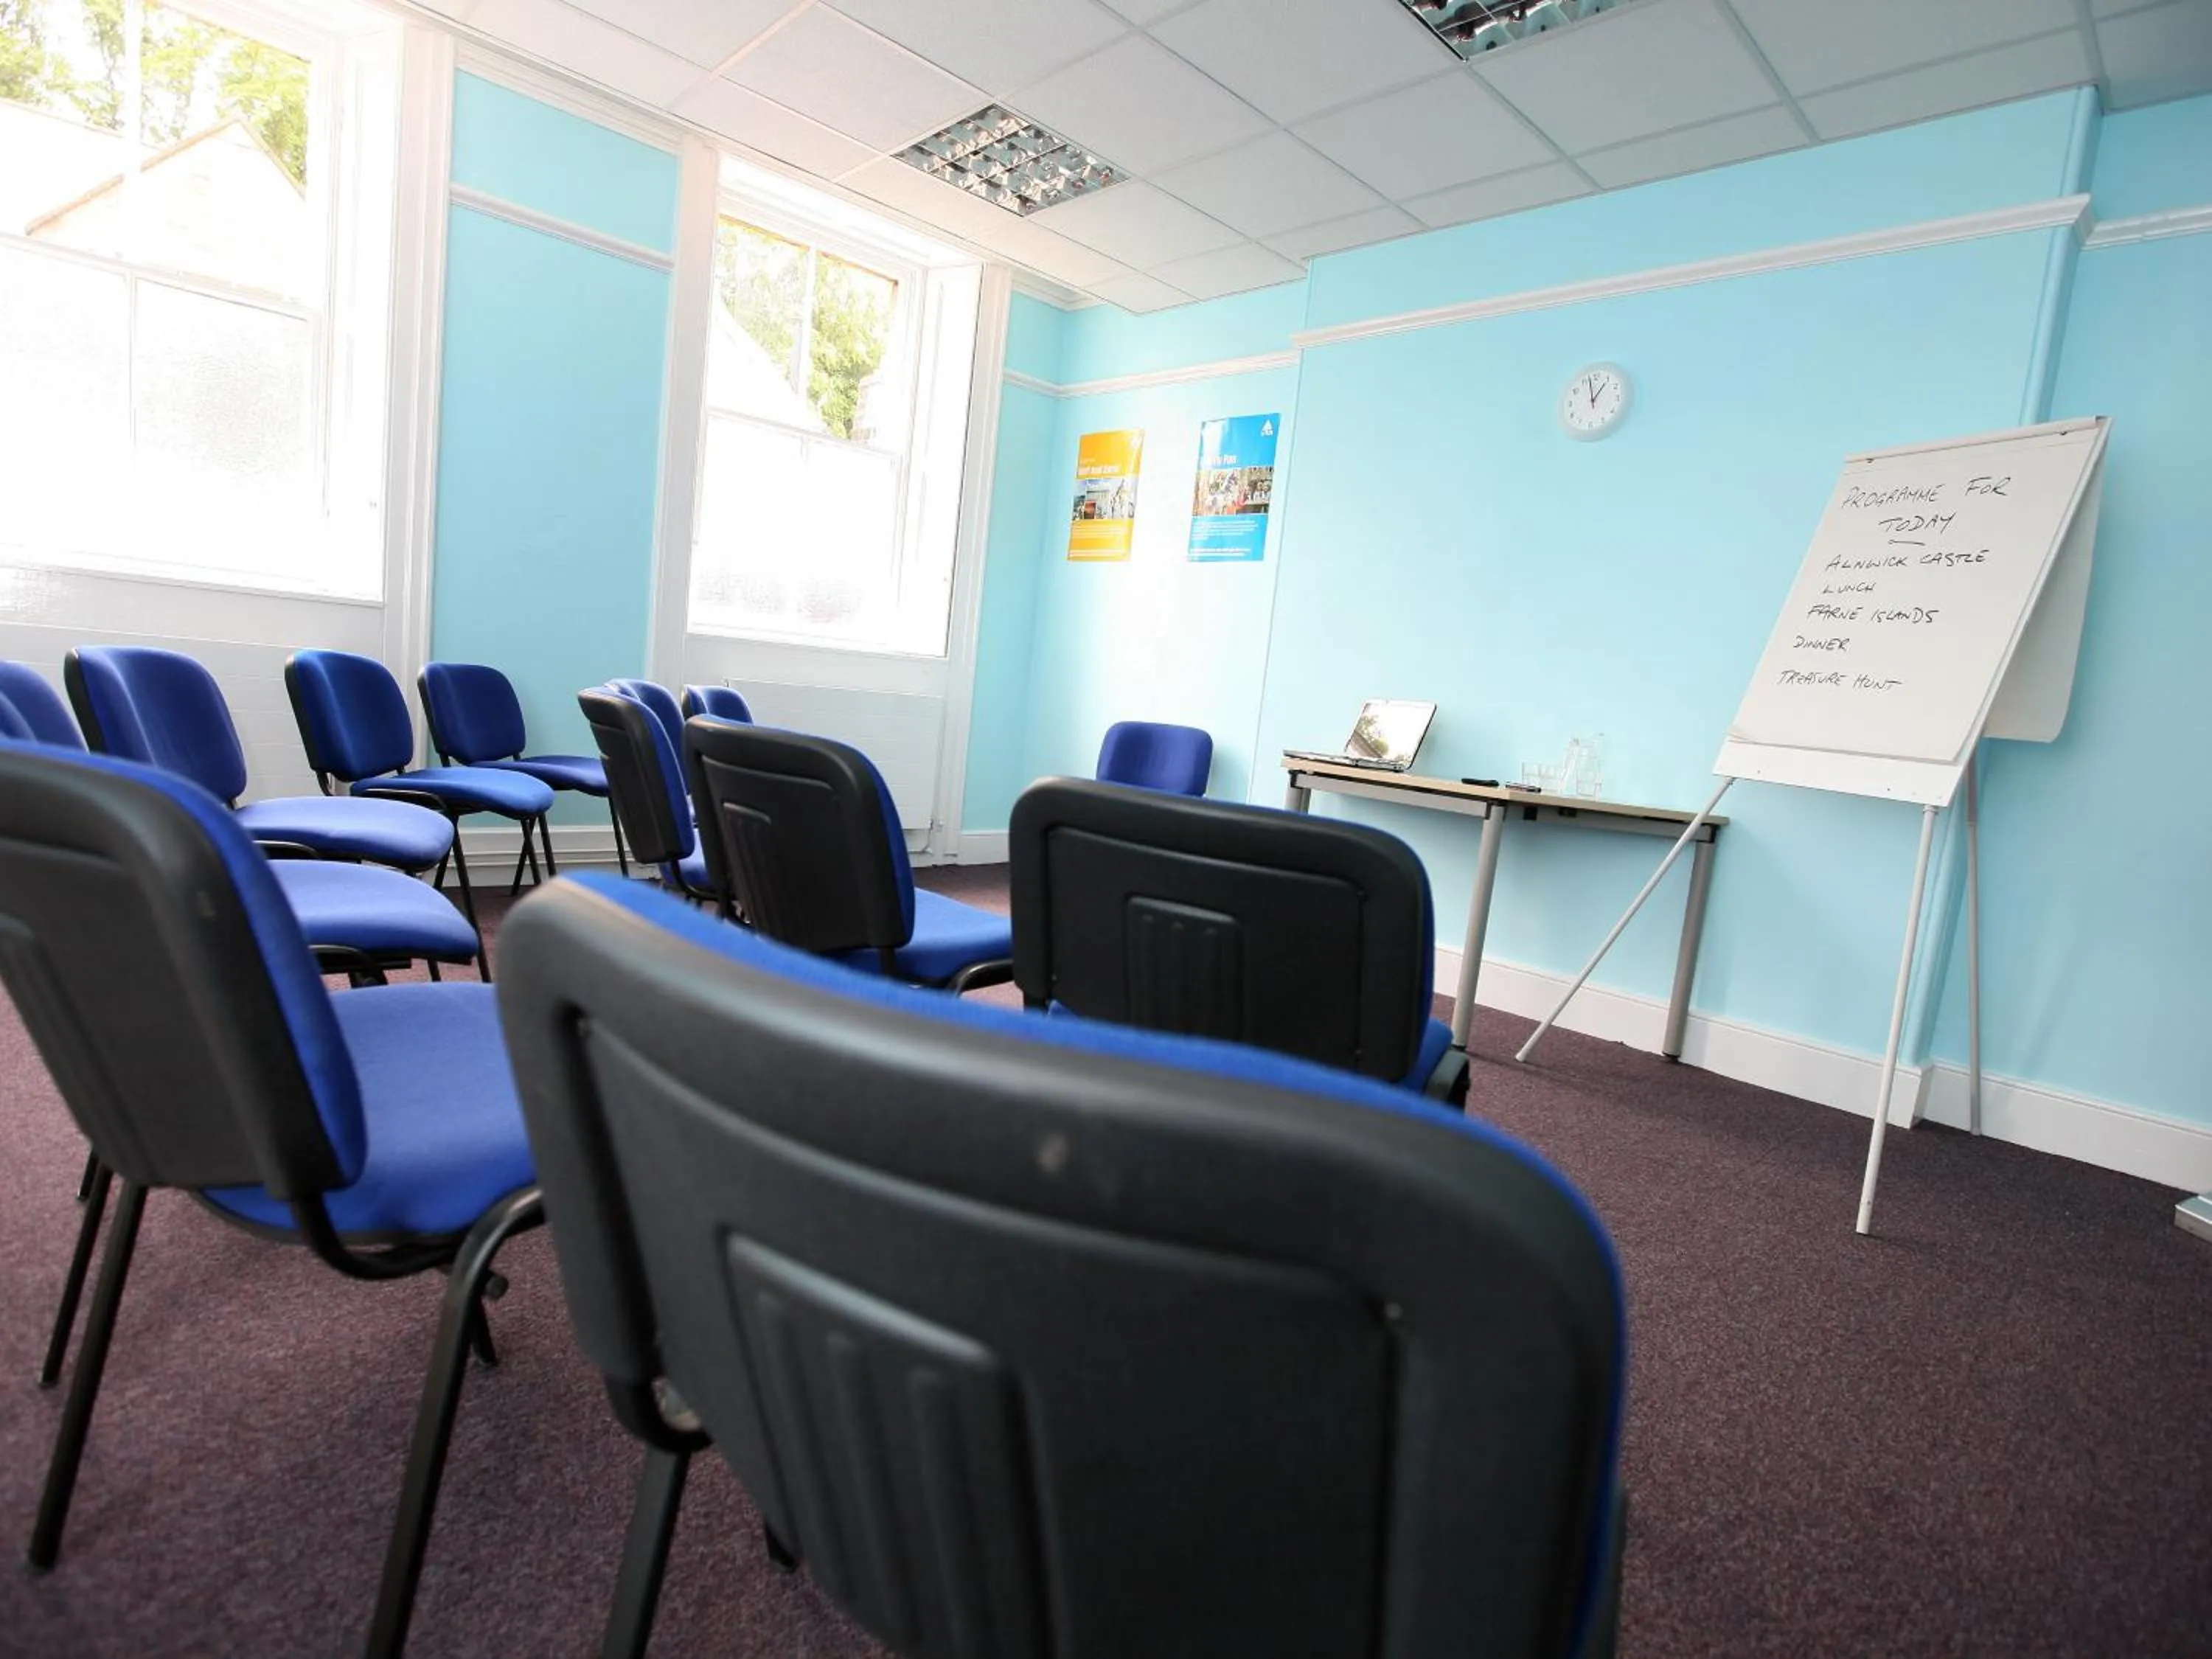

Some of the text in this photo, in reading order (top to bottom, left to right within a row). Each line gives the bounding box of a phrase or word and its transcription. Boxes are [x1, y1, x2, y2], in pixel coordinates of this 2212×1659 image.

[1841, 476, 2011, 508] PROGRAMME FOR
[1878, 512, 1956, 534] TODAY
[1825, 549, 1989, 571] ALNWICK CASTLE
[1822, 582, 1877, 594] LUNCH
[1808, 605, 1939, 624] FARNE ISLANDS
[1792, 635, 1849, 652] DINNER
[1776, 669, 1904, 689] TREASURE HUNT
